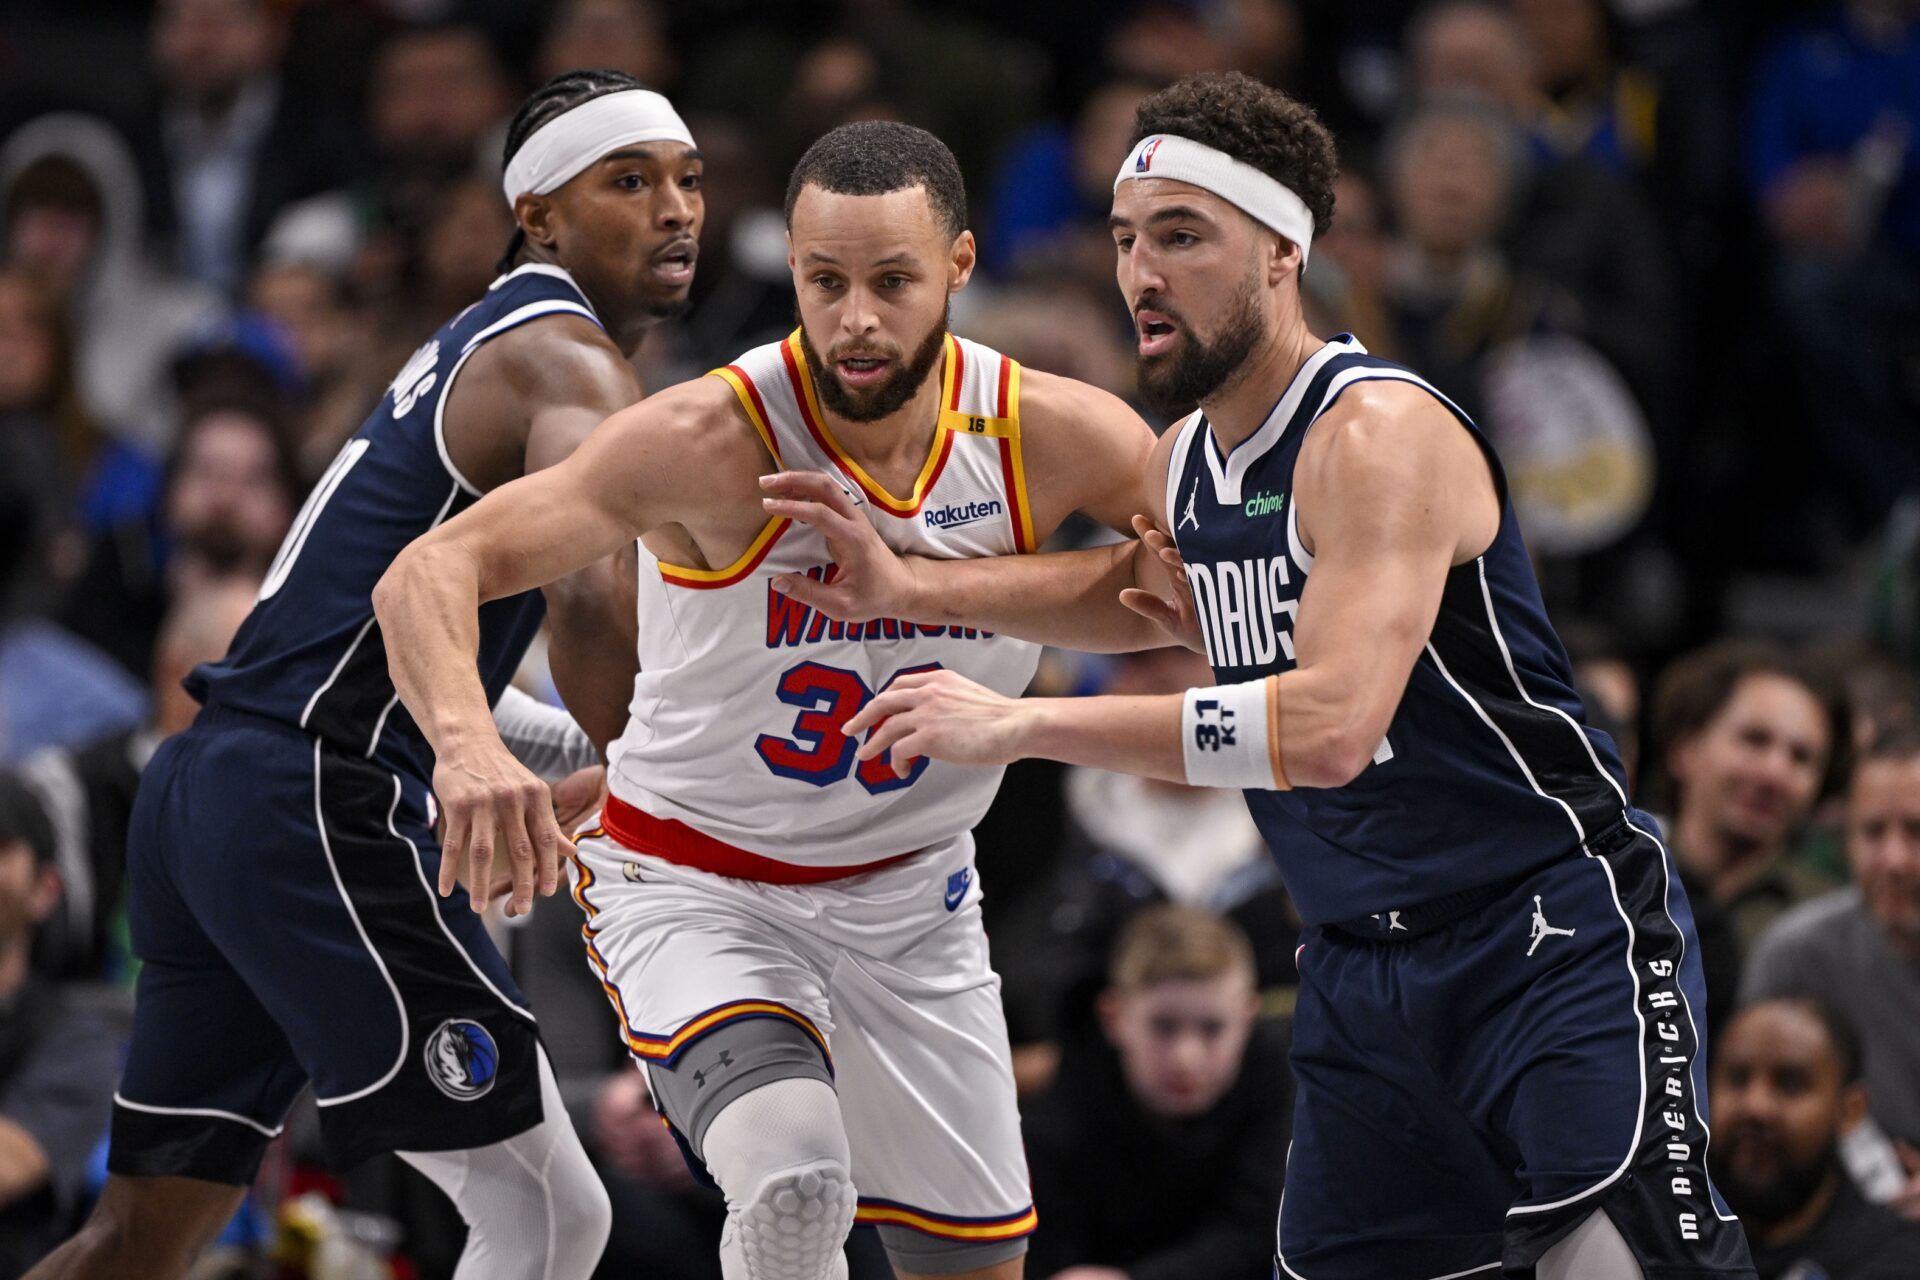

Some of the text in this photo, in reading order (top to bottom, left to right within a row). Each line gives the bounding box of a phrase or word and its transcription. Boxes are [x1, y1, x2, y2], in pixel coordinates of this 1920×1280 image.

[967, 416, 986, 433] 16
[924, 500, 1001, 529] Rakuten
[1245, 490, 1285, 517] chime
[1195, 700, 1220, 752] 31
[1220, 706, 1237, 746] KT
